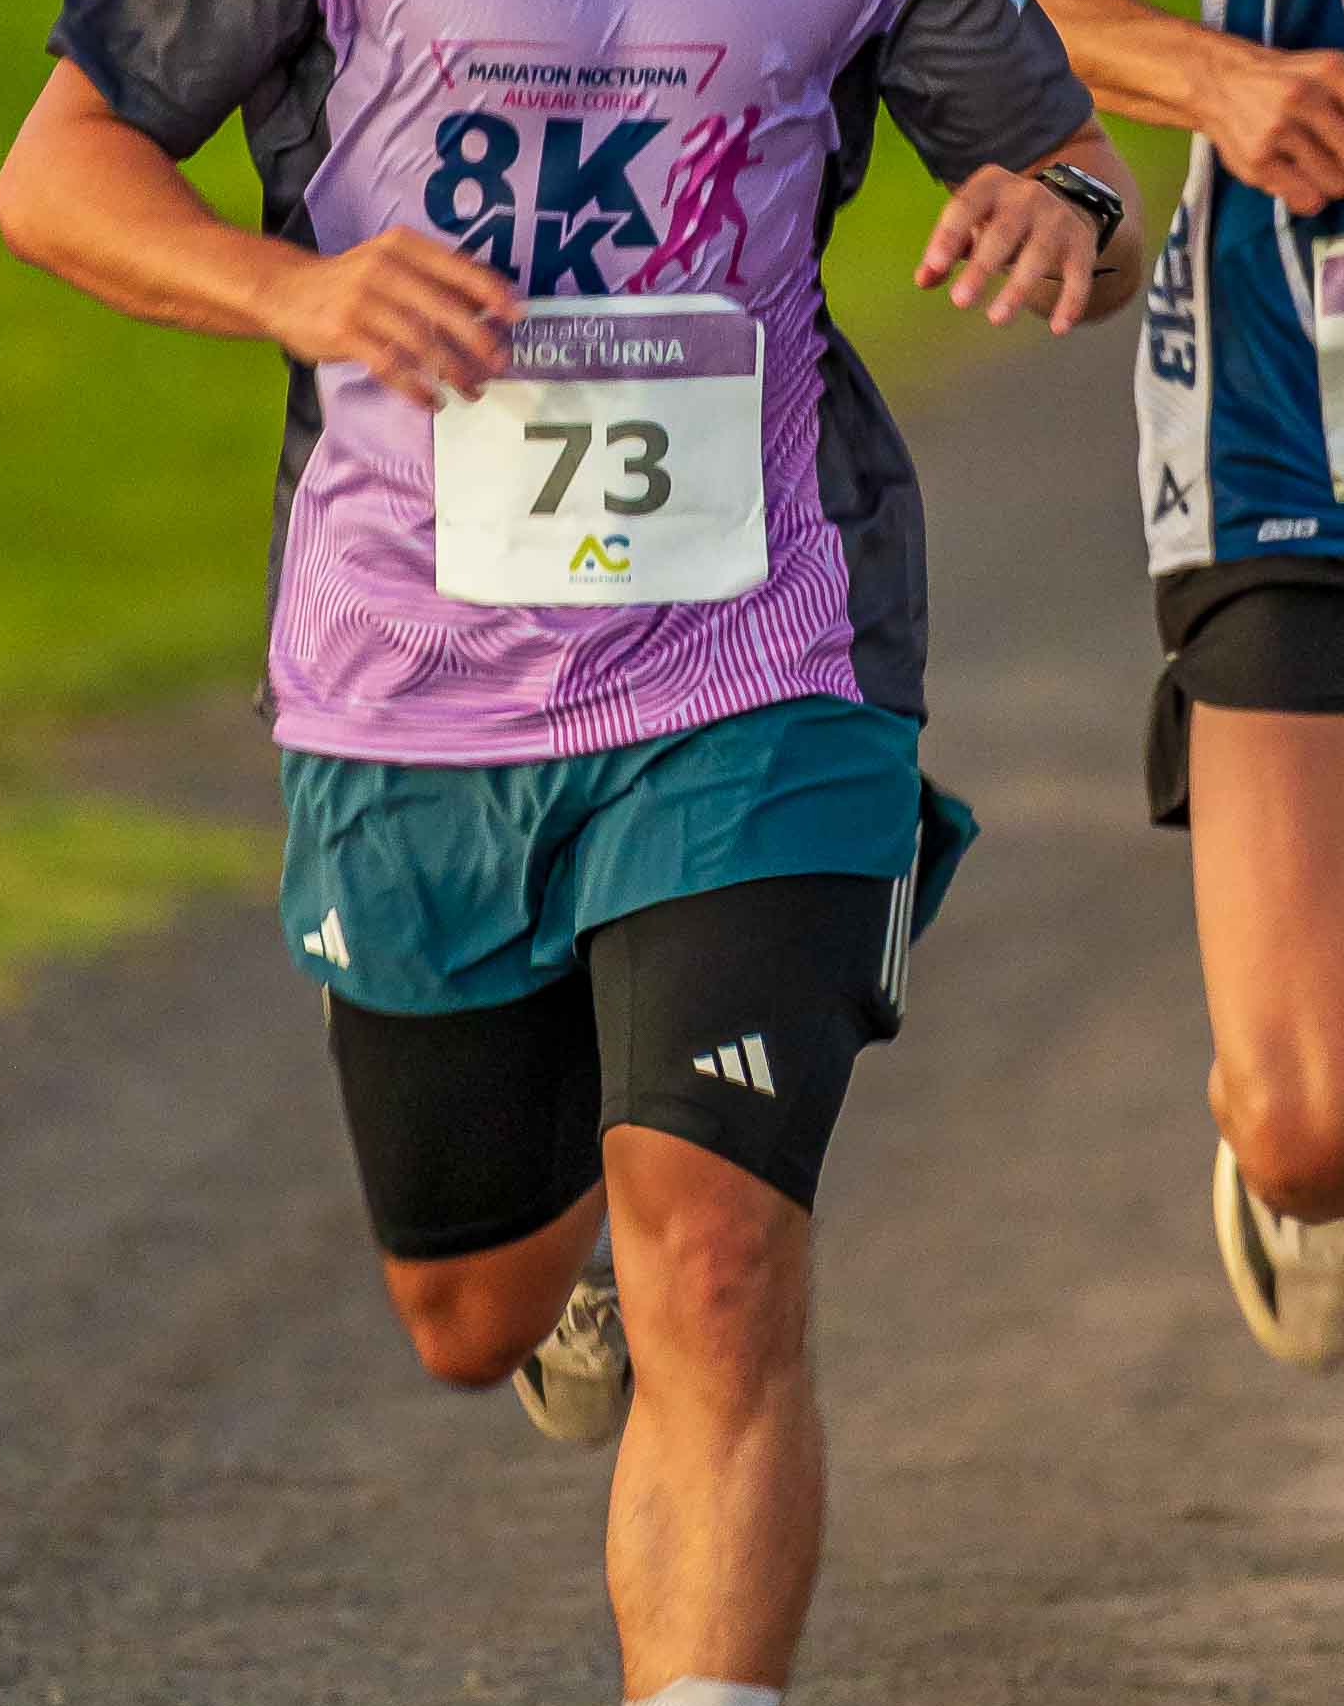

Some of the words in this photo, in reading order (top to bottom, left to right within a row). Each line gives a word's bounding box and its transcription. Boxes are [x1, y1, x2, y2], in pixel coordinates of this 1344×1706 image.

[468, 61, 571, 83] MARATON
[577, 63, 687, 86] NOCTURNA
[424, 112, 671, 246] 8K
[512, 340, 686, 367] NOCTURNA
[524, 419, 672, 516] 73
[569, 534, 631, 572] AC
